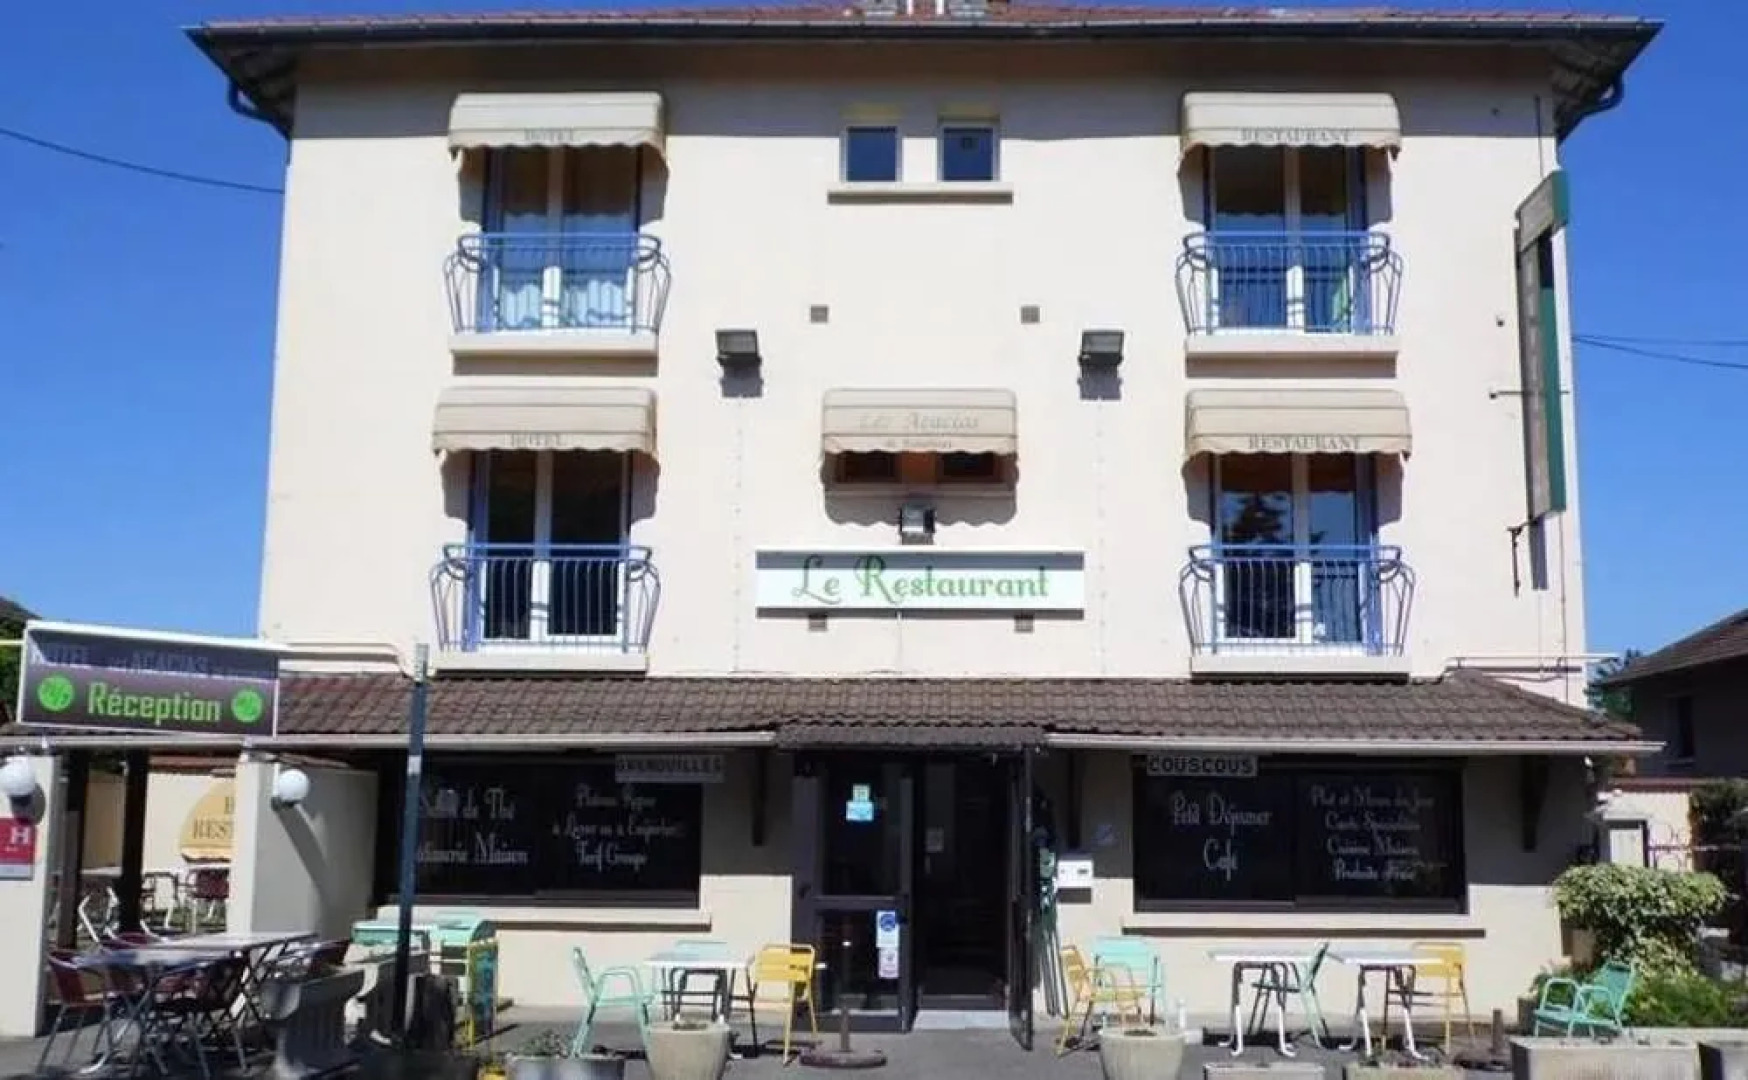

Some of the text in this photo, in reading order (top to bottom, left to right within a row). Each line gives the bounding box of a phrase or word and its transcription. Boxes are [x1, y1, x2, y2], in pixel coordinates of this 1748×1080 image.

[1241, 127, 1353, 142] RESTAURANT
[1249, 433, 1360, 449] RESTAURANT
[791, 555, 1050, 604] Le Restaurant
[88, 682, 221, 726] Réception
[1150, 757, 1252, 773] COUSCOUS
